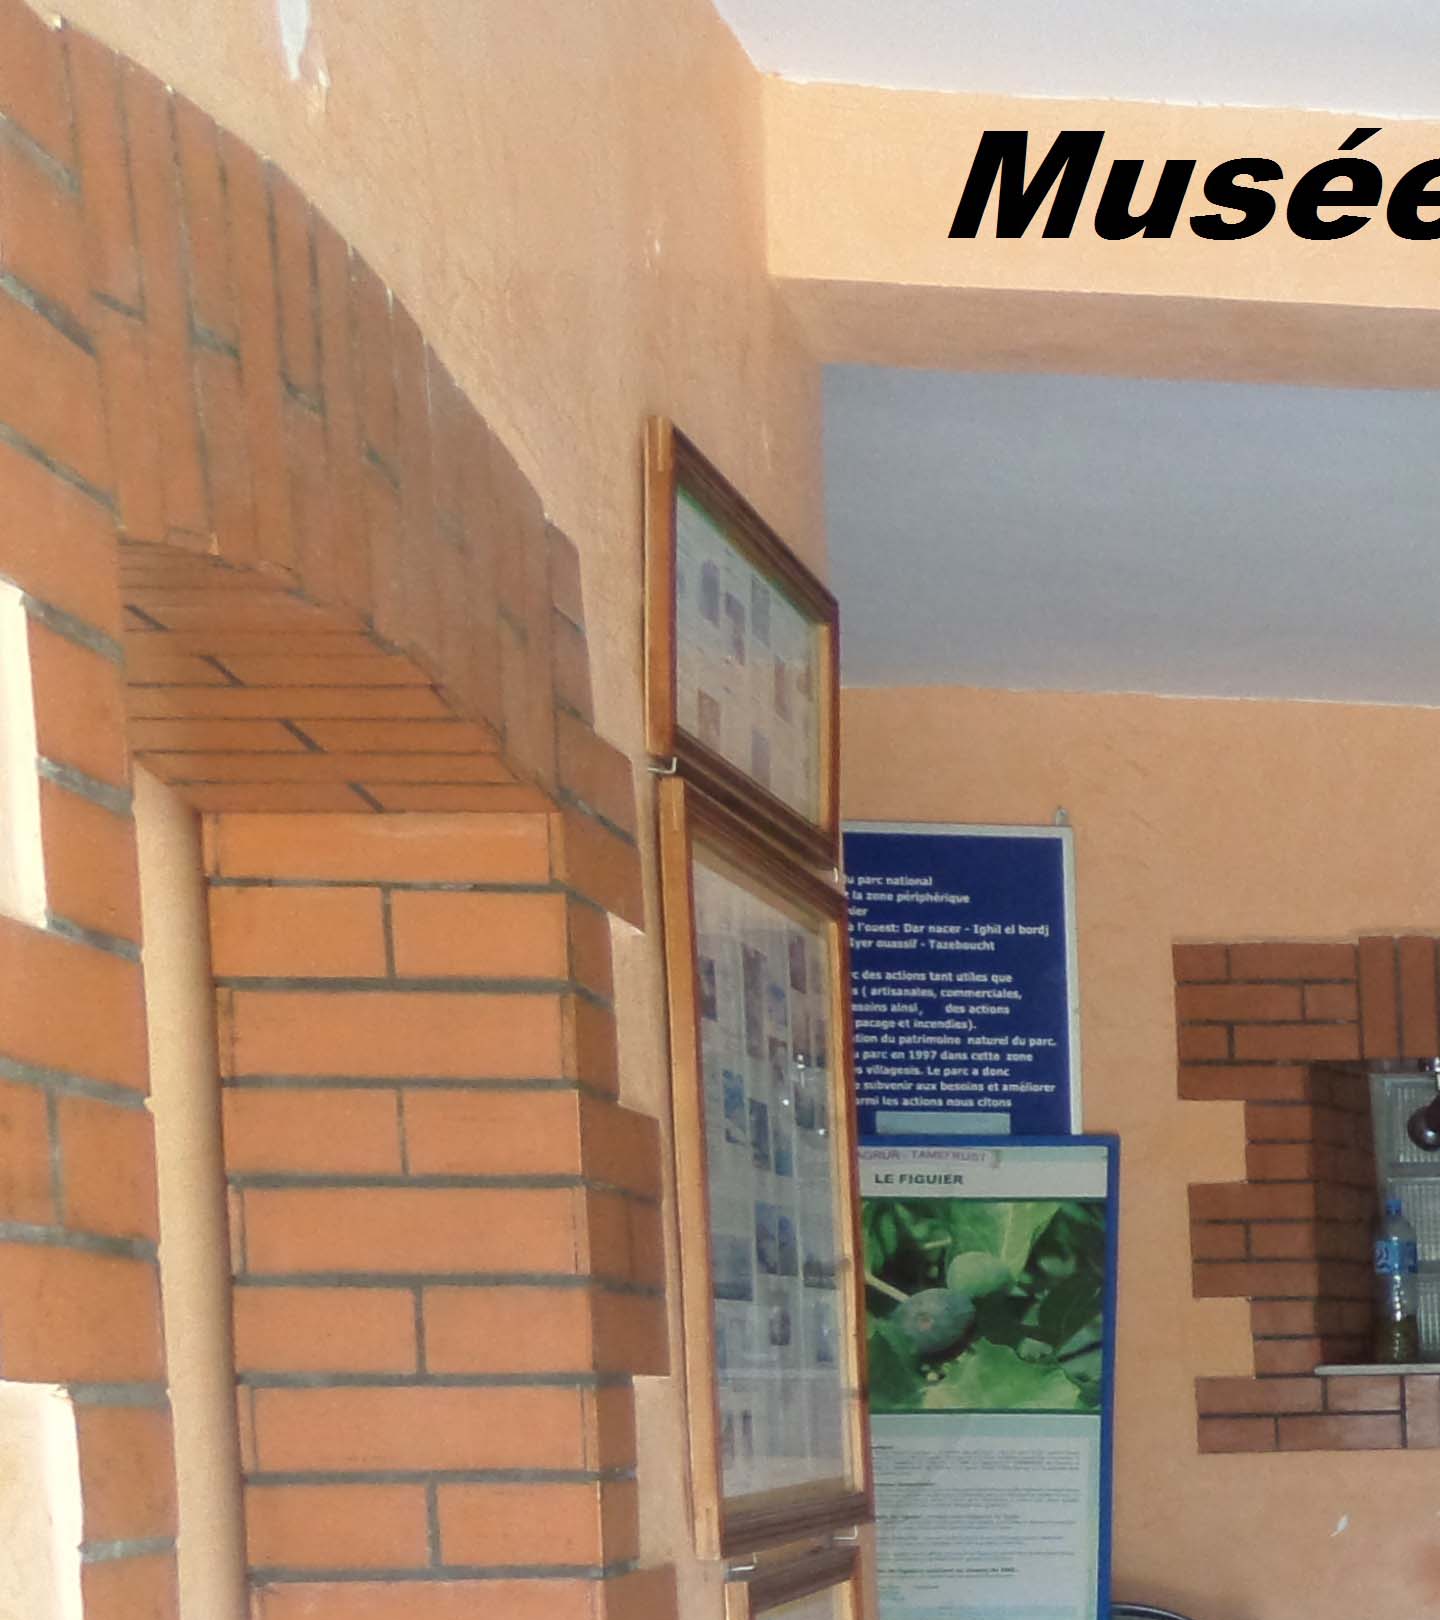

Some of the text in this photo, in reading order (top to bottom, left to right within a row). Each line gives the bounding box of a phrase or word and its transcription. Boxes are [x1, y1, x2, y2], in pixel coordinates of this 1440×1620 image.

[857, 876, 883, 887] parc
[886, 876, 933, 887] national
[896, 890, 970, 904] périphérique
[903, 922, 925, 933] Dar
[928, 924, 961, 934] nacer
[1018, 924, 1050, 937] bordj
[862, 970, 883, 981] des
[885, 971, 927, 982] actions
[929, 971, 953, 982] tant
[956, 971, 988, 983] utiles
[991, 973, 1013, 985] que
[968, 1004, 1011, 1015] actions
[881, 1034, 896, 1044] du
[898, 1035, 961, 1047] patrimoine
[967, 1035, 1009, 1046] naturel
[1011, 1036, 1027, 1046] du
[862, 1050, 888, 1061] parc
[908, 1050, 937, 1061] 1997
[940, 1050, 968, 1061] dans
[971, 1051, 1000, 1061] cette
[1006, 1052, 1034, 1062] zone
[927, 1066, 941, 1076] Le
[943, 1067, 969, 1077] parc
[982, 1066, 1011, 1077] donc
[939, 1081, 985, 1092] besoins
[987, 1082, 999, 1092] et
[882, 1096, 899, 1107] les
[902, 1096, 944, 1108] actions
[977, 1097, 1013, 1108] citons
[874, 1173, 965, 1185] LE FIGUIER
